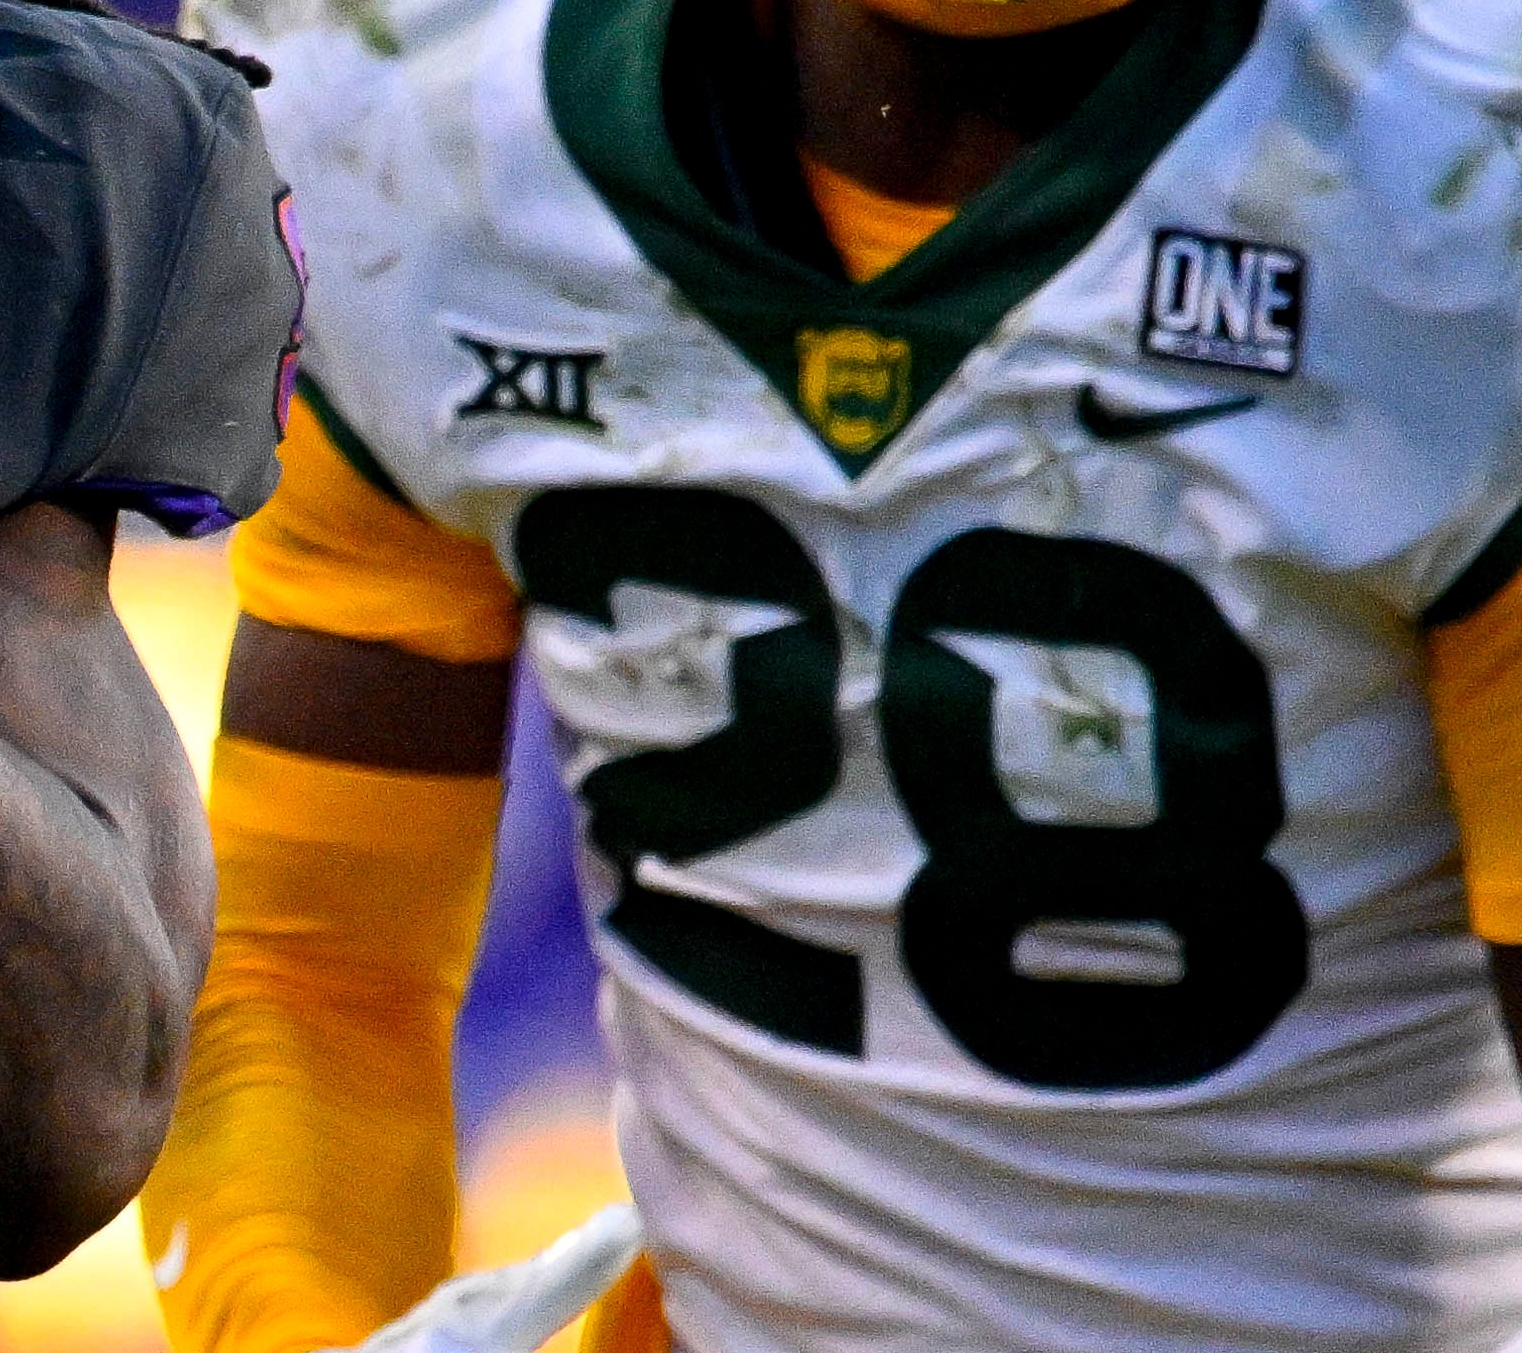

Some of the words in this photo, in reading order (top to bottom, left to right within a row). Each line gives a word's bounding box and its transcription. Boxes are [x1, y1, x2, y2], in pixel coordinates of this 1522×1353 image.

[1155, 236, 1296, 343] ONE
[452, 330, 609, 432] XII
[516, 485, 1310, 1093] 28
